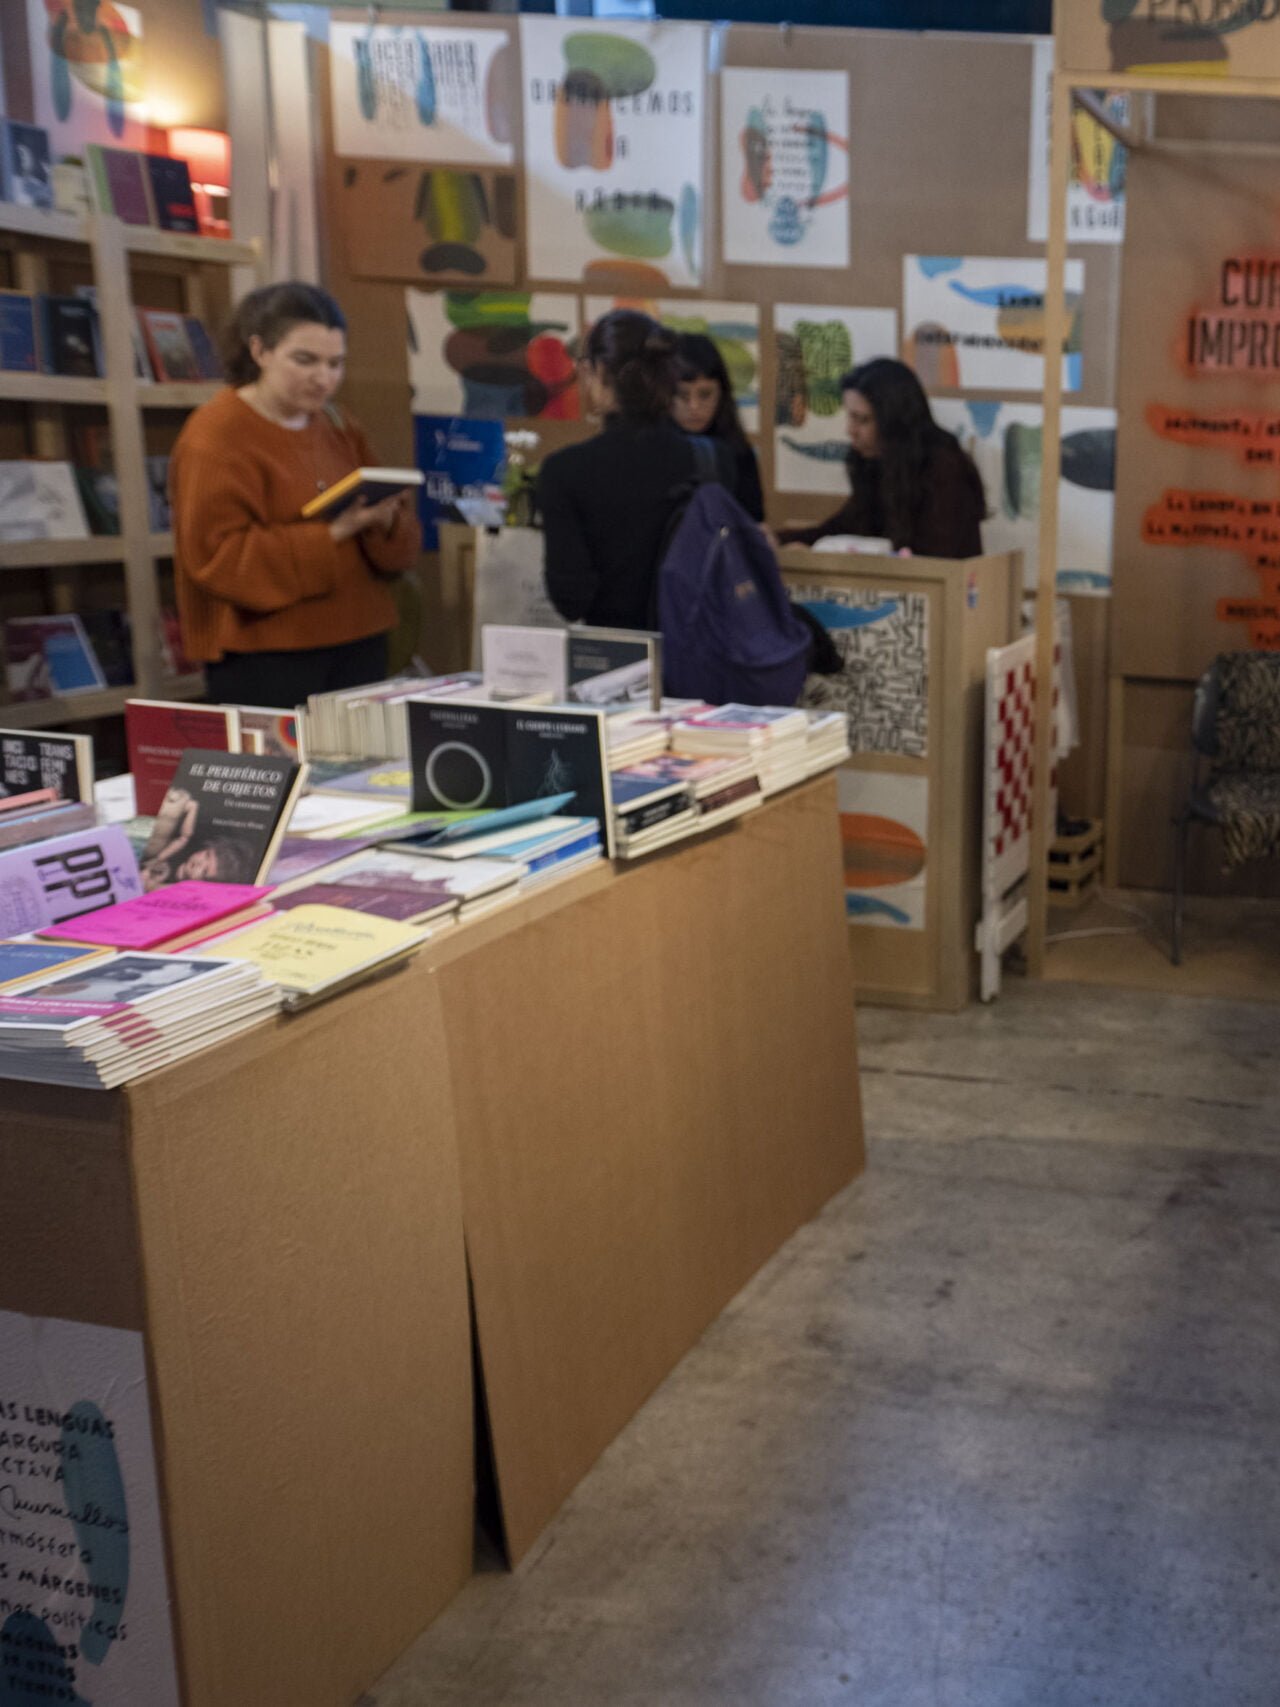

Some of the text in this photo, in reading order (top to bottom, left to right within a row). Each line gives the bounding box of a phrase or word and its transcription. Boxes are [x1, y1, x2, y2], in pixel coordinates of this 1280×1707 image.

[189, 764, 283, 783] EL PERIFÉRICO
[202, 780, 277, 799] DE OBJETOS
[24, 1405, 115, 1440] LENGUAS
[18, 1567, 122, 1605] MÁRGENES
